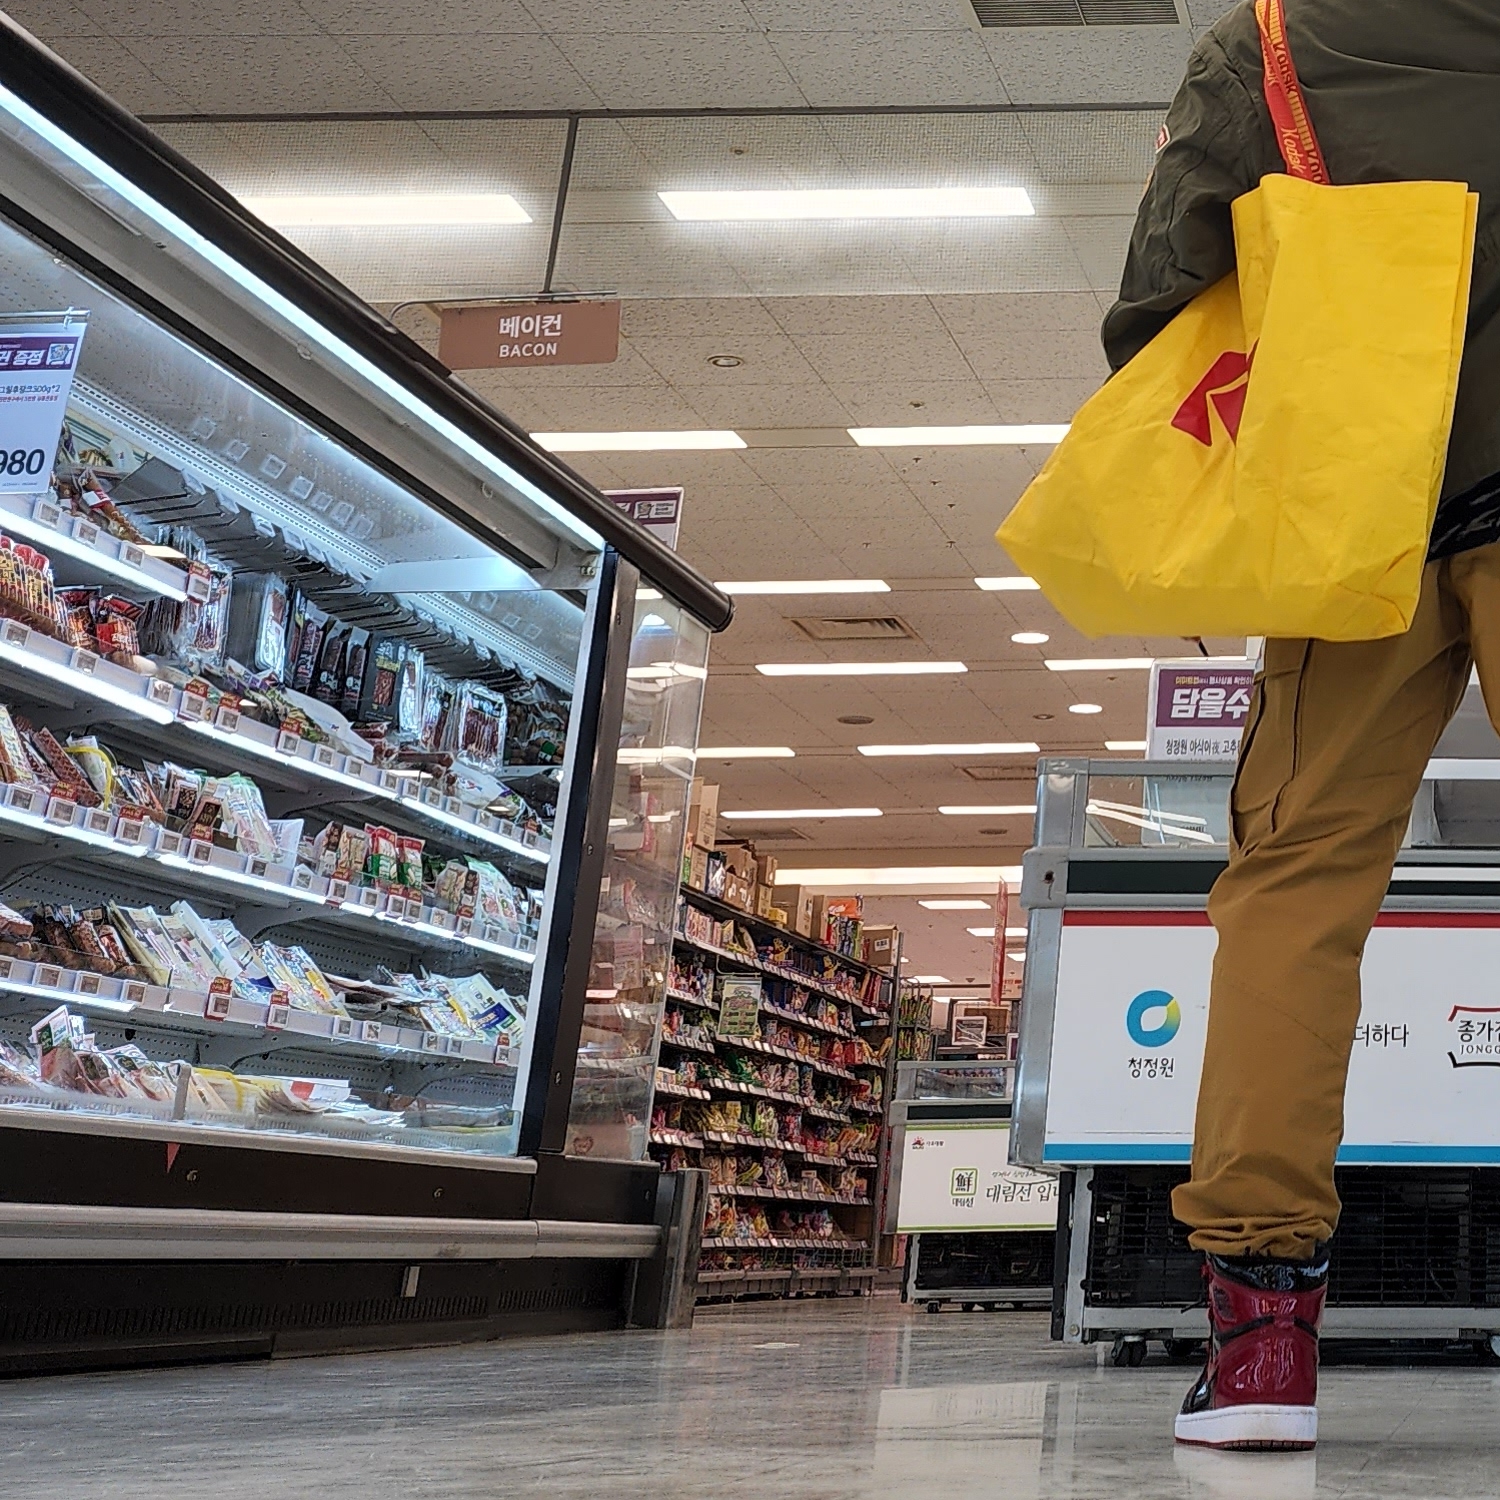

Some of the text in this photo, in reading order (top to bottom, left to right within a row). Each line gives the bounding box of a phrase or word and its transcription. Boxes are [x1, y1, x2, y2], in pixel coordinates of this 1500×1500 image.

[1280, 127, 1308, 175] Kodak
[498, 313, 562, 339] 베이컨
[498, 342, 557, 359] BACON
[1166, 738, 1188, 756] 청정원
[1222, 738, 1242, 756] 고추
[1128, 1057, 1174, 1079] 청정원
[986, 1183, 1032, 1203] 대림선
